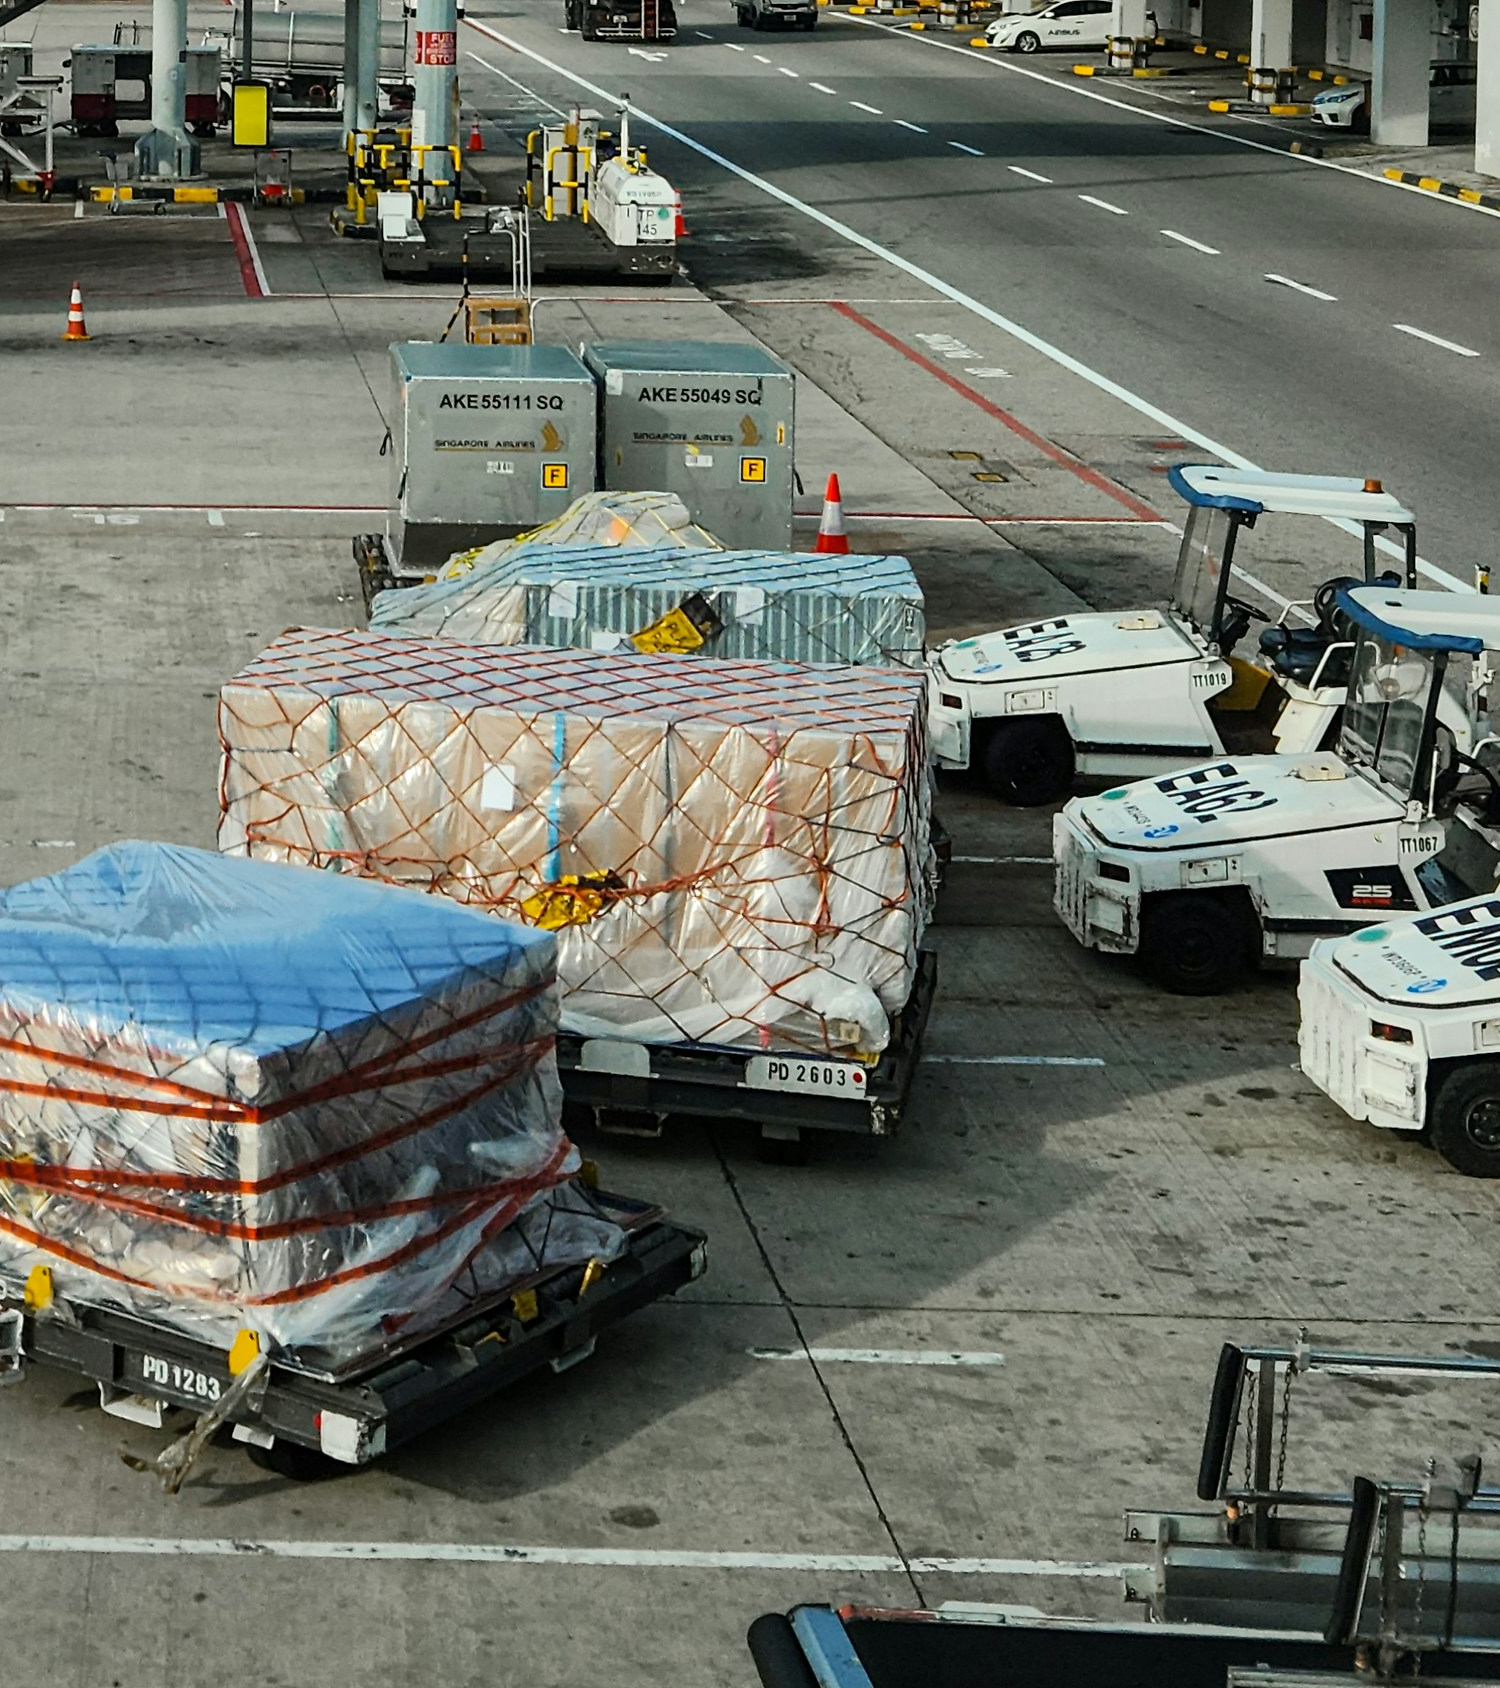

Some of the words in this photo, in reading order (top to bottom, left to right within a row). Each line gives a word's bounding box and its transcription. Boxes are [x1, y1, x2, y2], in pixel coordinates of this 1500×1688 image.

[440, 394, 478, 409] AKE
[482, 394, 531, 410] 55111
[537, 395, 564, 411] SQ
[638, 388, 677, 402] AKE
[681, 388, 731, 404] 55049
[735, 390, 762, 406] SQ
[435, 440, 489, 448] SINGAPORE
[495, 440, 535, 448] AIRLINES
[550, 469, 560, 483] F
[748, 463, 758, 477] F
[1192, 672, 1227, 688] TT1019
[1400, 837, 1438, 853] TT1067
[1352, 884, 1392, 898] 25
[767, 1061, 790, 1083] PD
[795, 1061, 848, 1088] 2603
[143, 1353, 169, 1384] PD
[173, 1363, 221, 1402] 1283
